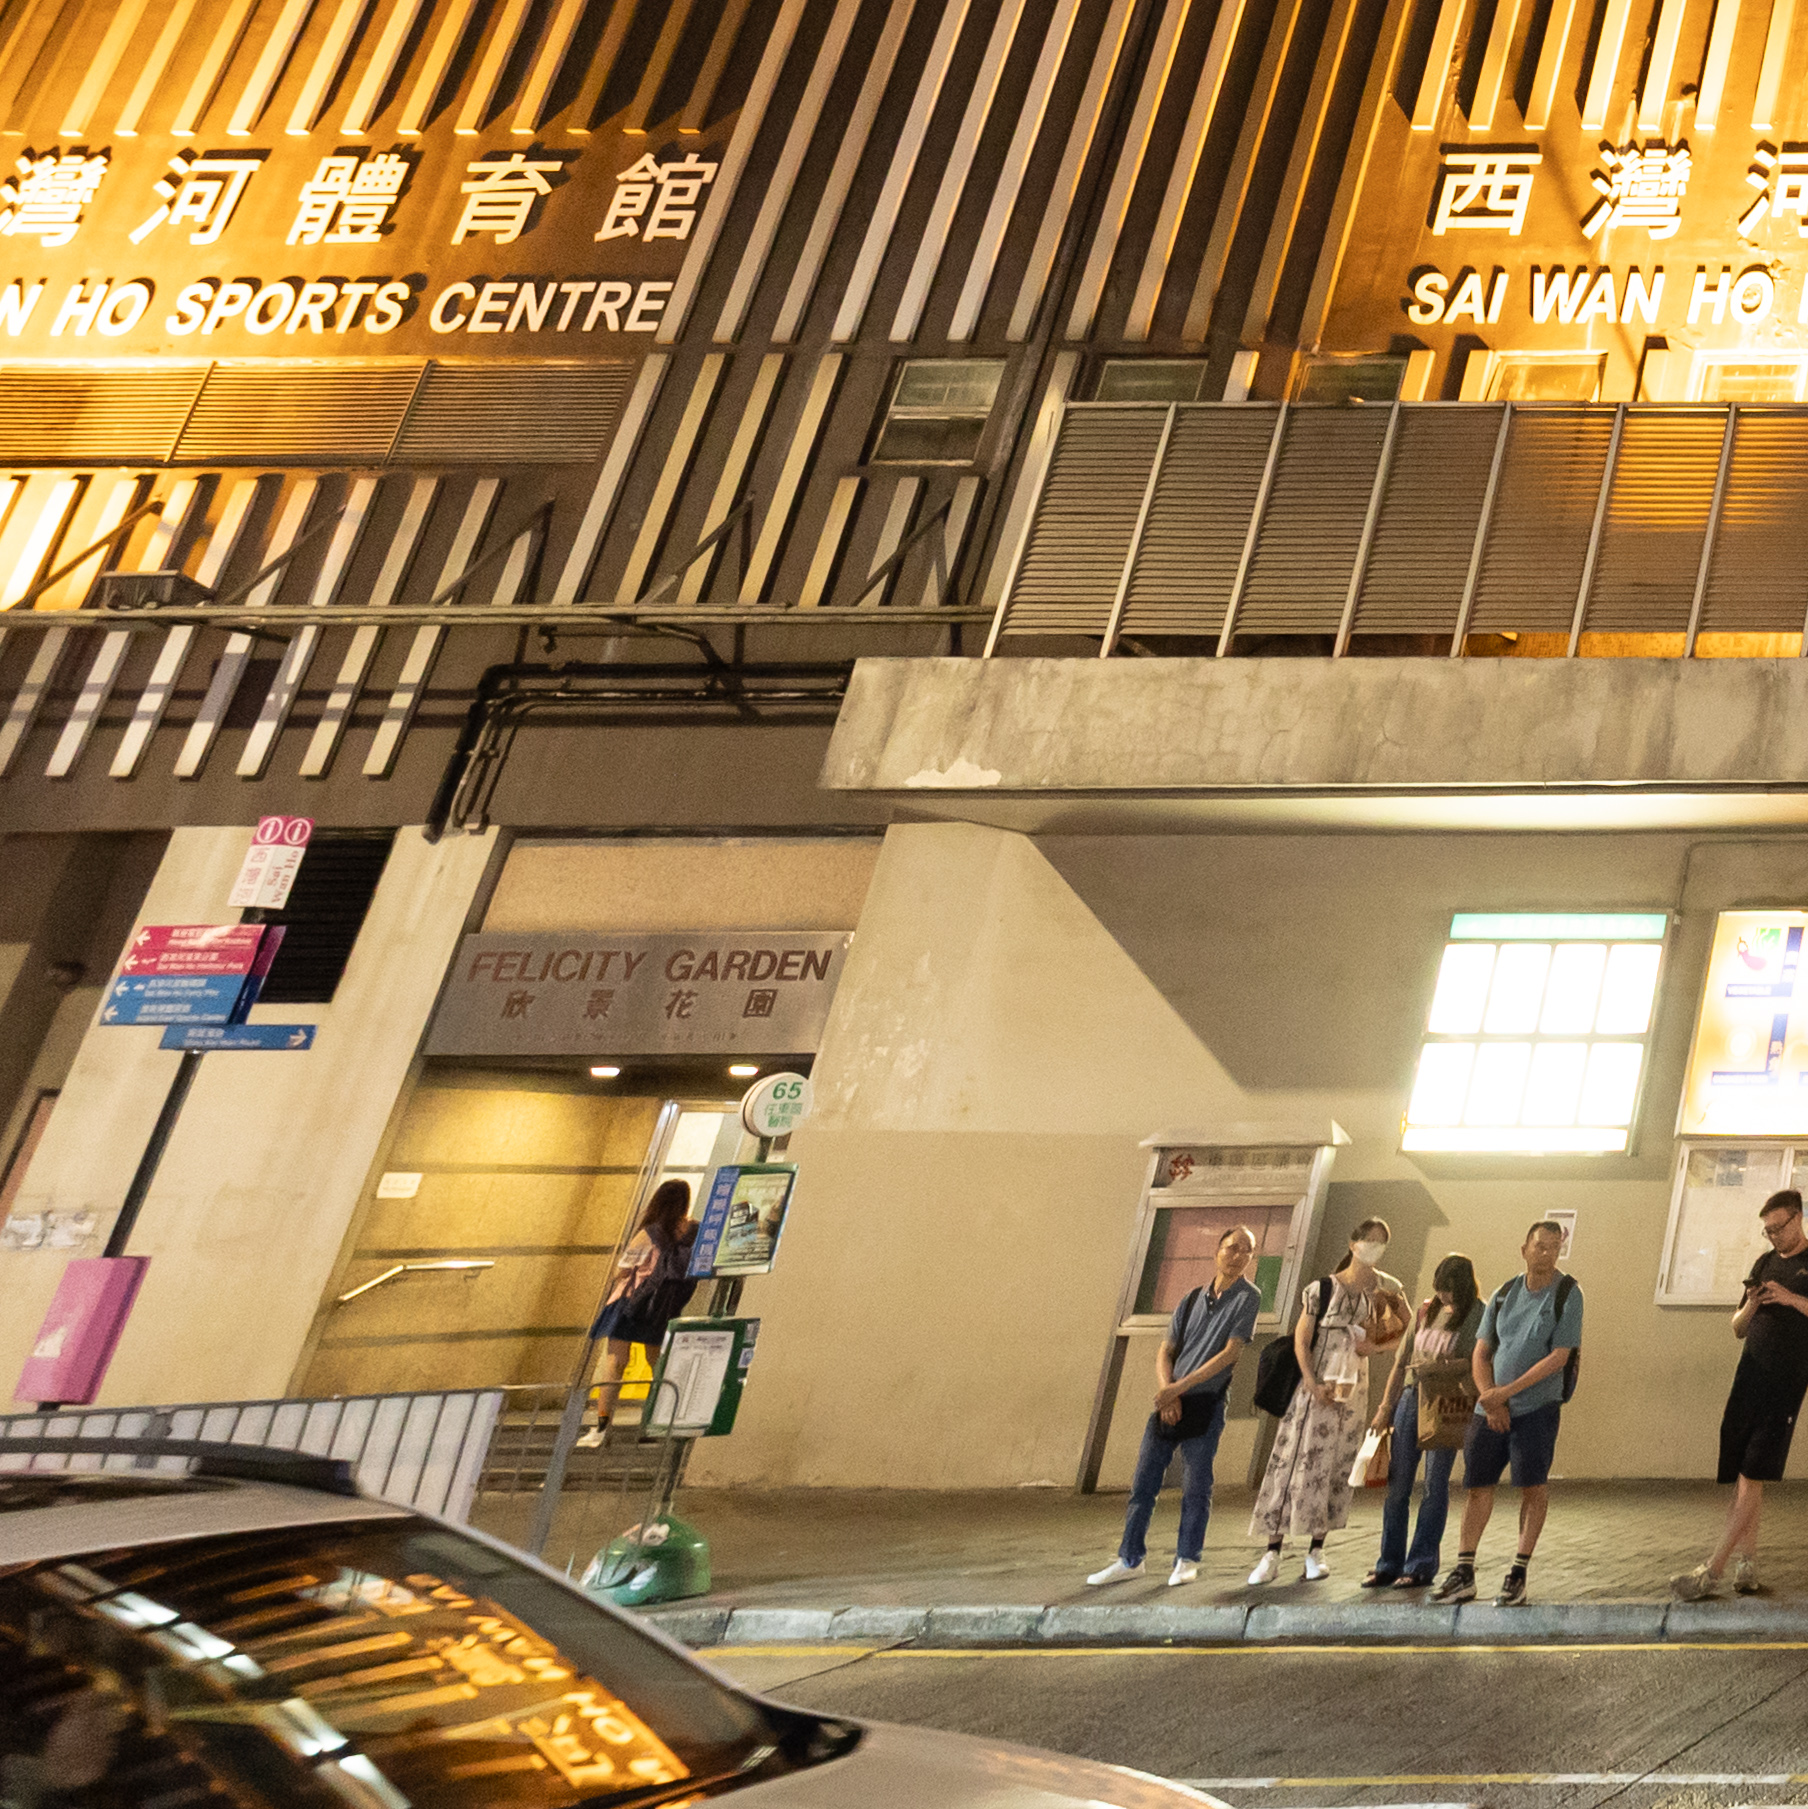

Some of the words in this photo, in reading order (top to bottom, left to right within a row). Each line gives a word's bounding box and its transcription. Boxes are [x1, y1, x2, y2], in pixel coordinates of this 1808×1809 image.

[0, 153, 717, 247] 灣河體育館
[50, 282, 150, 336] HO
[165, 282, 411, 335] SPORTS
[429, 282, 675, 333] CENTRE
[1408, 271, 1508, 325] SAI
[1533, 271, 1664, 325] WAN
[1687, 271, 1774, 325] HO
[467, 949, 648, 983] FELICITY
[664, 949, 833, 982] GARDEN
[772, 1081, 802, 1101] 65
